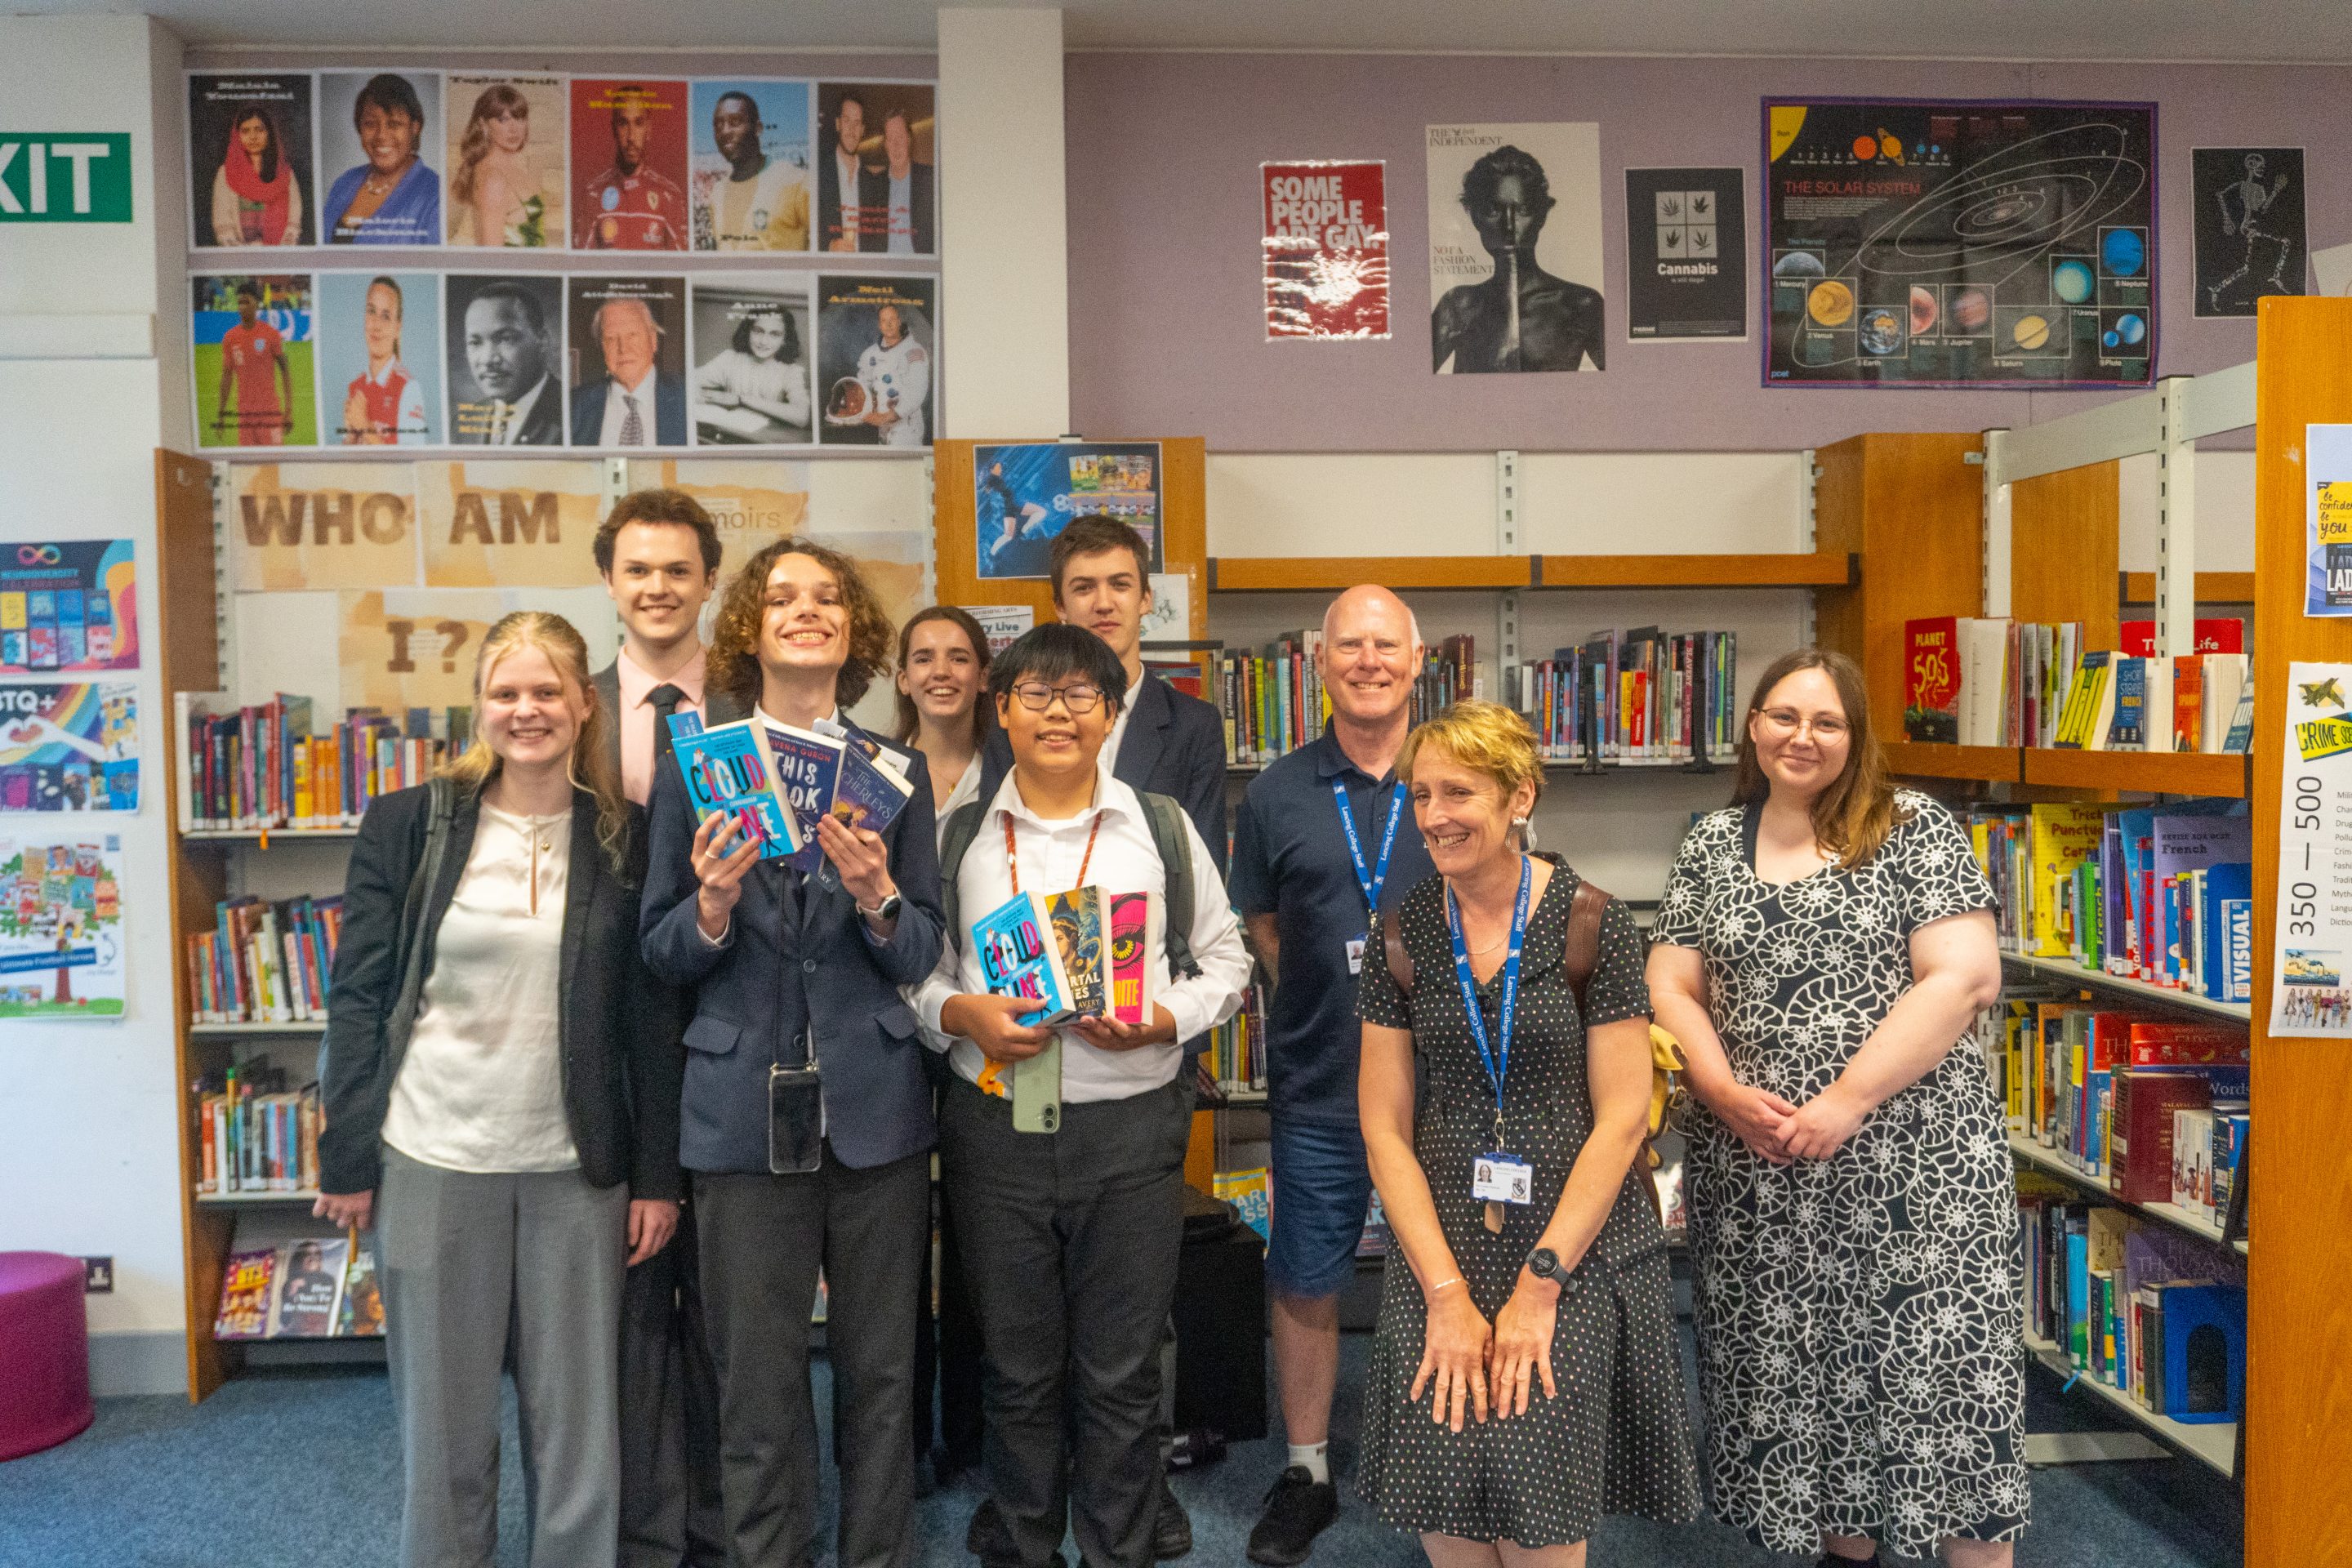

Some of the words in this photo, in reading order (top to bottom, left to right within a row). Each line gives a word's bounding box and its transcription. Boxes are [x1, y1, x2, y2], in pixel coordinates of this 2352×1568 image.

[1430, 136, 1503, 146] INDEPENDENT
[1270, 176, 1343, 201] SOME
[1784, 181, 1811, 194] THE
[1815, 180, 1864, 194] SOLAR
[1866, 181, 1921, 195] SYSTEM
[1272, 200, 1364, 225] PEOPLE
[1274, 225, 1322, 249] ARE
[1325, 224, 1380, 249] GAY.
[1434, 256, 1477, 264] FASHION
[1434, 265, 1494, 274] STATEMENT
[1657, 262, 1718, 275] Cannabis
[239, 493, 406, 548] WHO
[449, 492, 561, 546] AM
[2320, 522, 2347, 540] you
[996, 622, 1019, 631] Live
[1915, 631, 1945, 647] PLANET
[0, 690, 56, 714] TQ+
[2296, 721, 2339, 752] CRIME
[800, 747, 832, 763] GURON
[689, 752, 765, 804] CLOUD
[772, 751, 817, 786] THIS
[857, 769, 872, 787] THE
[785, 786, 822, 813] OK
[840, 771, 893, 819] CHERLEYS
[1392, 797, 1401, 812] Staff
[2295, 776, 2322, 831] 500
[1387, 813, 1398, 835] College
[1342, 806, 1352, 831] Lancing
[1348, 830, 1358, 853] College
[1356, 853, 1365, 868] Staff
[1381, 835, 1393, 861] Lancing
[2162, 844, 2209, 855] French
[1521, 862, 1530, 889] Lancing
[1518, 889, 1529, 918] College
[2290, 882, 2317, 937] 350
[1450, 908, 1460, 940] Lancing
[1516, 917, 1525, 932] Staff
[983, 920, 1040, 981] CLOUD
[2234, 910, 2251, 981] VISUAL
[1069, 971, 1101, 987] RTAL
[1462, 981, 1472, 1001] Staff
[1505, 976, 1516, 1004] Lancing
[1078, 999, 1100, 1009] AVERY
[1468, 1000, 1481, 1029] College
[1502, 1004, 1512, 1036] College
[1476, 1027, 1489, 1056] Lancing
